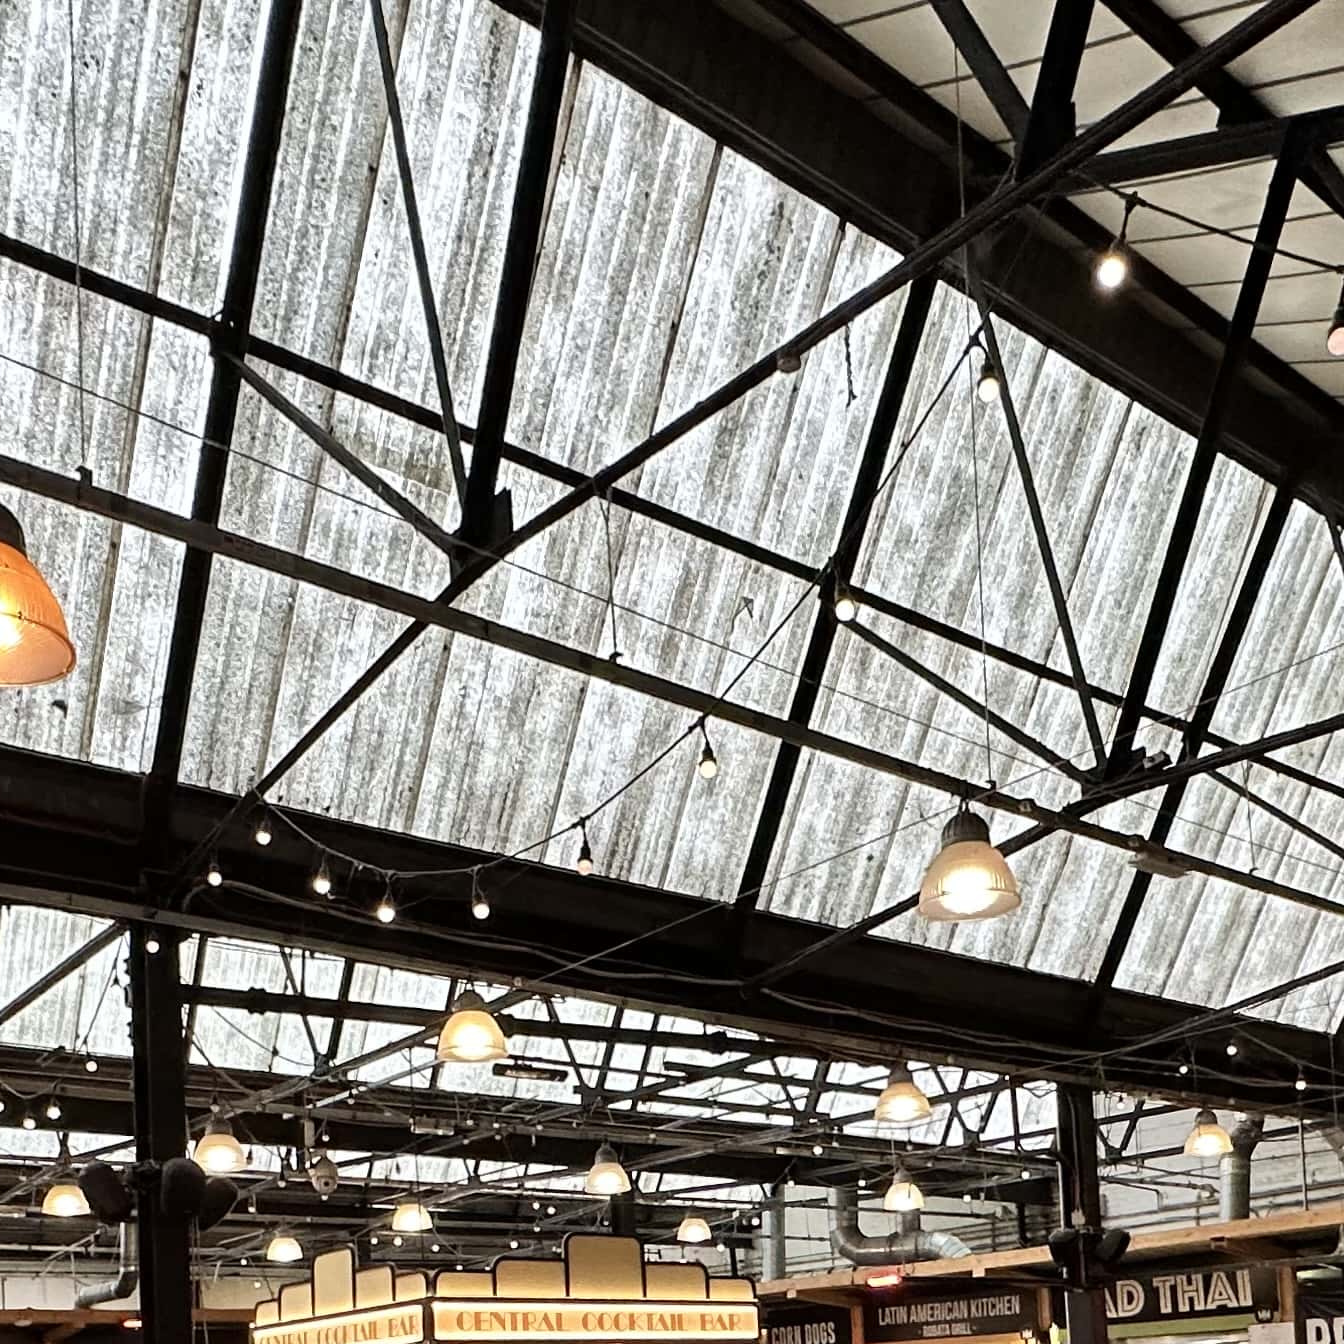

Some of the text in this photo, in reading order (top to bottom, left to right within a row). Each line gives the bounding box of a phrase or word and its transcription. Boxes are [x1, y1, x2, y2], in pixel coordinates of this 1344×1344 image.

[1152, 1268, 1254, 1315] THAI
[455, 1311, 743, 1332] CENTRAL COCKTAIL BAR
[877, 1294, 1021, 1326] LATIN AMERICAN KITCHEN
[387, 1314, 420, 1338] BAR
